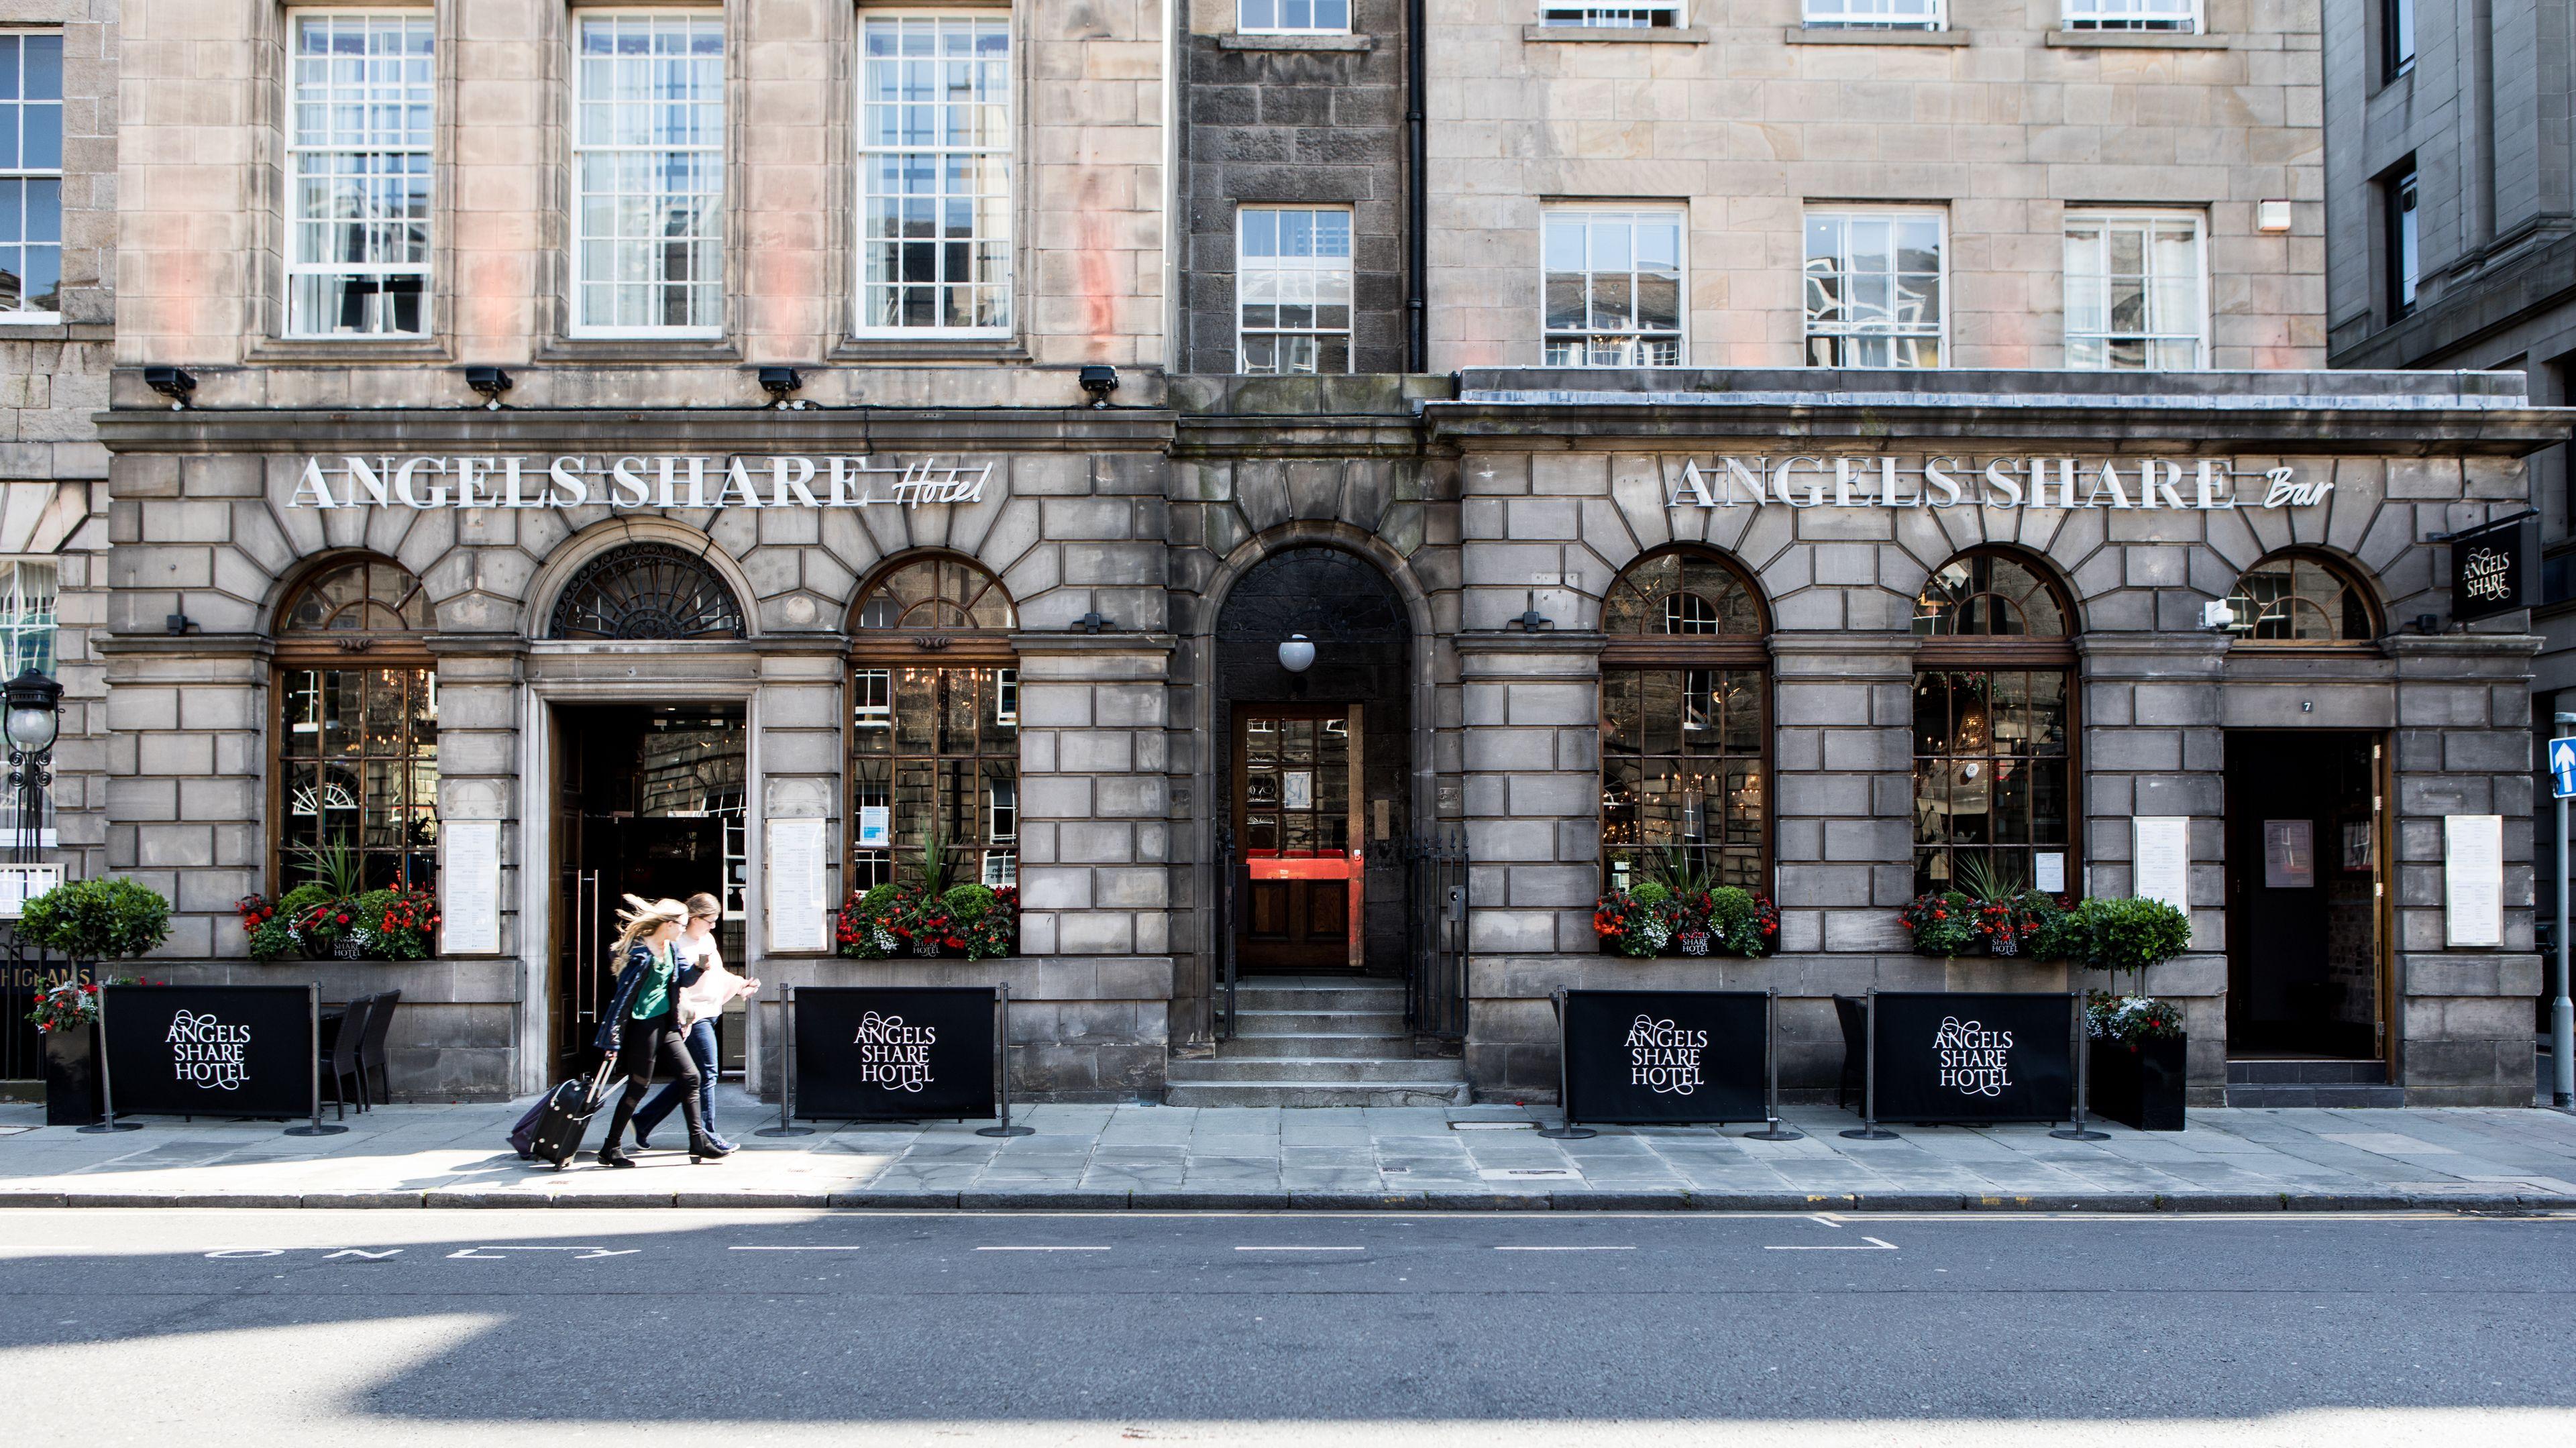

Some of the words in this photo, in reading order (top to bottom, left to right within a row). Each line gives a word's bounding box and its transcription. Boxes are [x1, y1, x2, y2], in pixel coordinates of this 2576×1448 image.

[284, 455, 588, 510] ANGELS
[611, 455, 870, 509] SHARE
[892, 457, 993, 510] Hotel
[1664, 456, 1962, 508] ANGELS
[1985, 457, 2236, 510] SHARE
[2261, 466, 2334, 509] Bar
[2463, 547, 2510, 580] ANGELS
[2467, 571, 2511, 601] SHARE
[2304, 702, 2311, 711] 7
[334, 949, 362, 960] HOTEL
[913, 947, 940, 957] HOTEL
[1682, 945, 1709, 955] HOTEL
[1992, 945, 2019, 956] HOTEL
[165, 1009, 251, 1043] ANGELS
[853, 1011, 936, 1044] ANGELS
[1623, 1014, 1708, 1048] ANGELS
[1932, 1016, 2013, 1049] ANGELS
[174, 1044, 245, 1064] SHARE
[861, 1045, 930, 1066] SHARE
[1631, 1048, 1701, 1068] SHARE
[1940, 1050, 2007, 1069] SHARE
[174, 1062, 250, 1091] HOTEL
[861, 1064, 934, 1093] HOTEL
[1631, 1067, 1705, 1095] HOTEL
[1939, 1069, 2012, 1097] HOTEL
